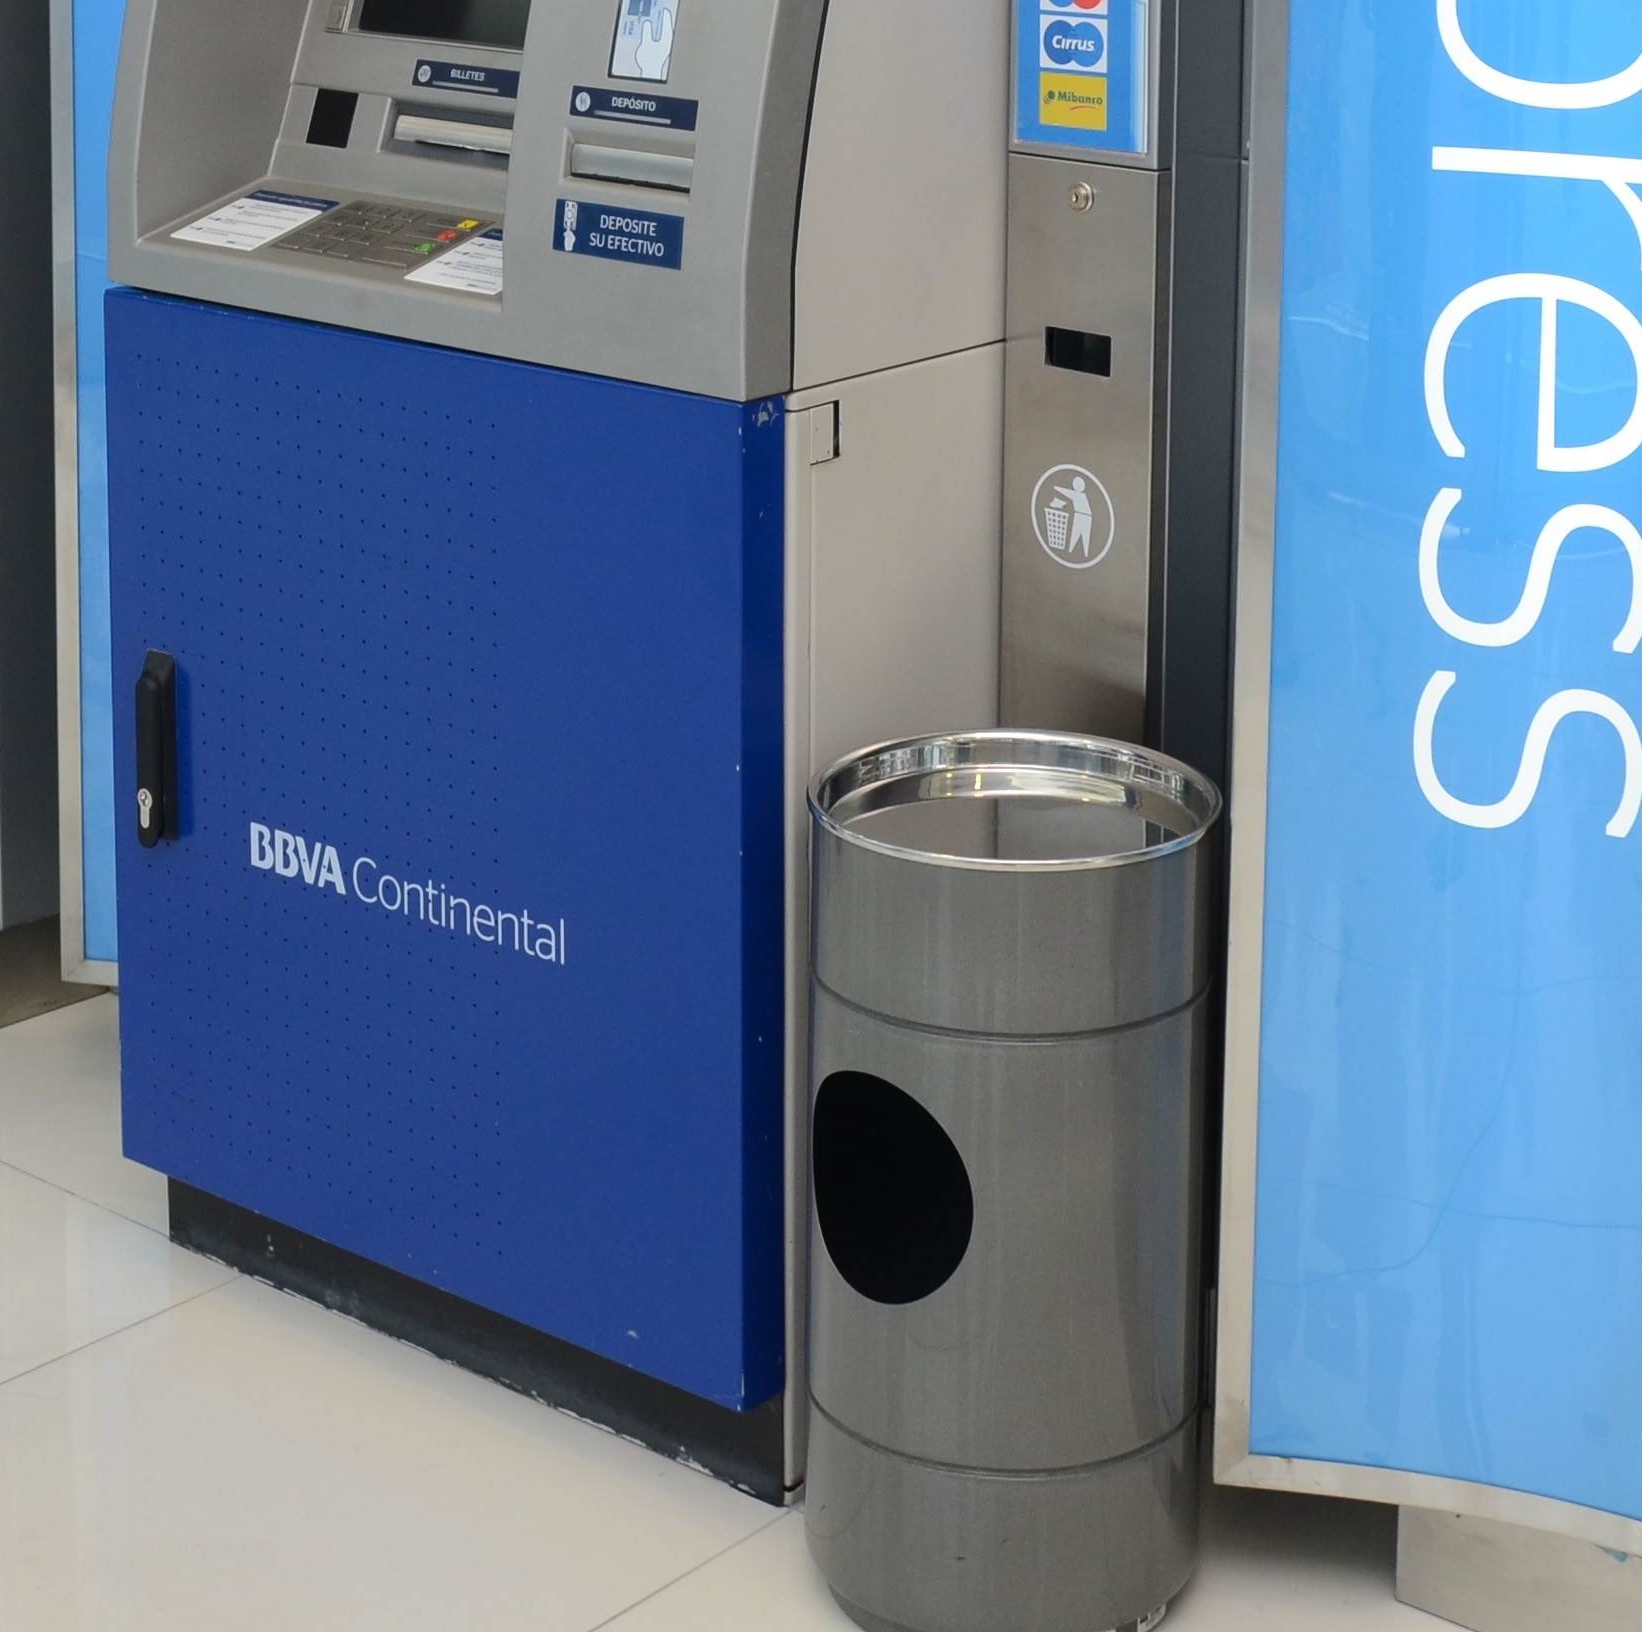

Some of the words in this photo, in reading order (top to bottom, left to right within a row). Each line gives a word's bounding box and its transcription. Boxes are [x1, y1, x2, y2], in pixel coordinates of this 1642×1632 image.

[1052, 34, 1096, 52] Cirrus
[450, 68, 485, 83] BILLETES
[611, 94, 656, 112] DEPÓSITO
[1058, 91, 1103, 106] Mibanco
[600, 214, 657, 237] DEPOSITE
[589, 232, 606, 248] SU
[607, 234, 665, 257] EFECTIVO
[250, 821, 347, 895] BBVA
[352, 856, 565, 966] Continental
